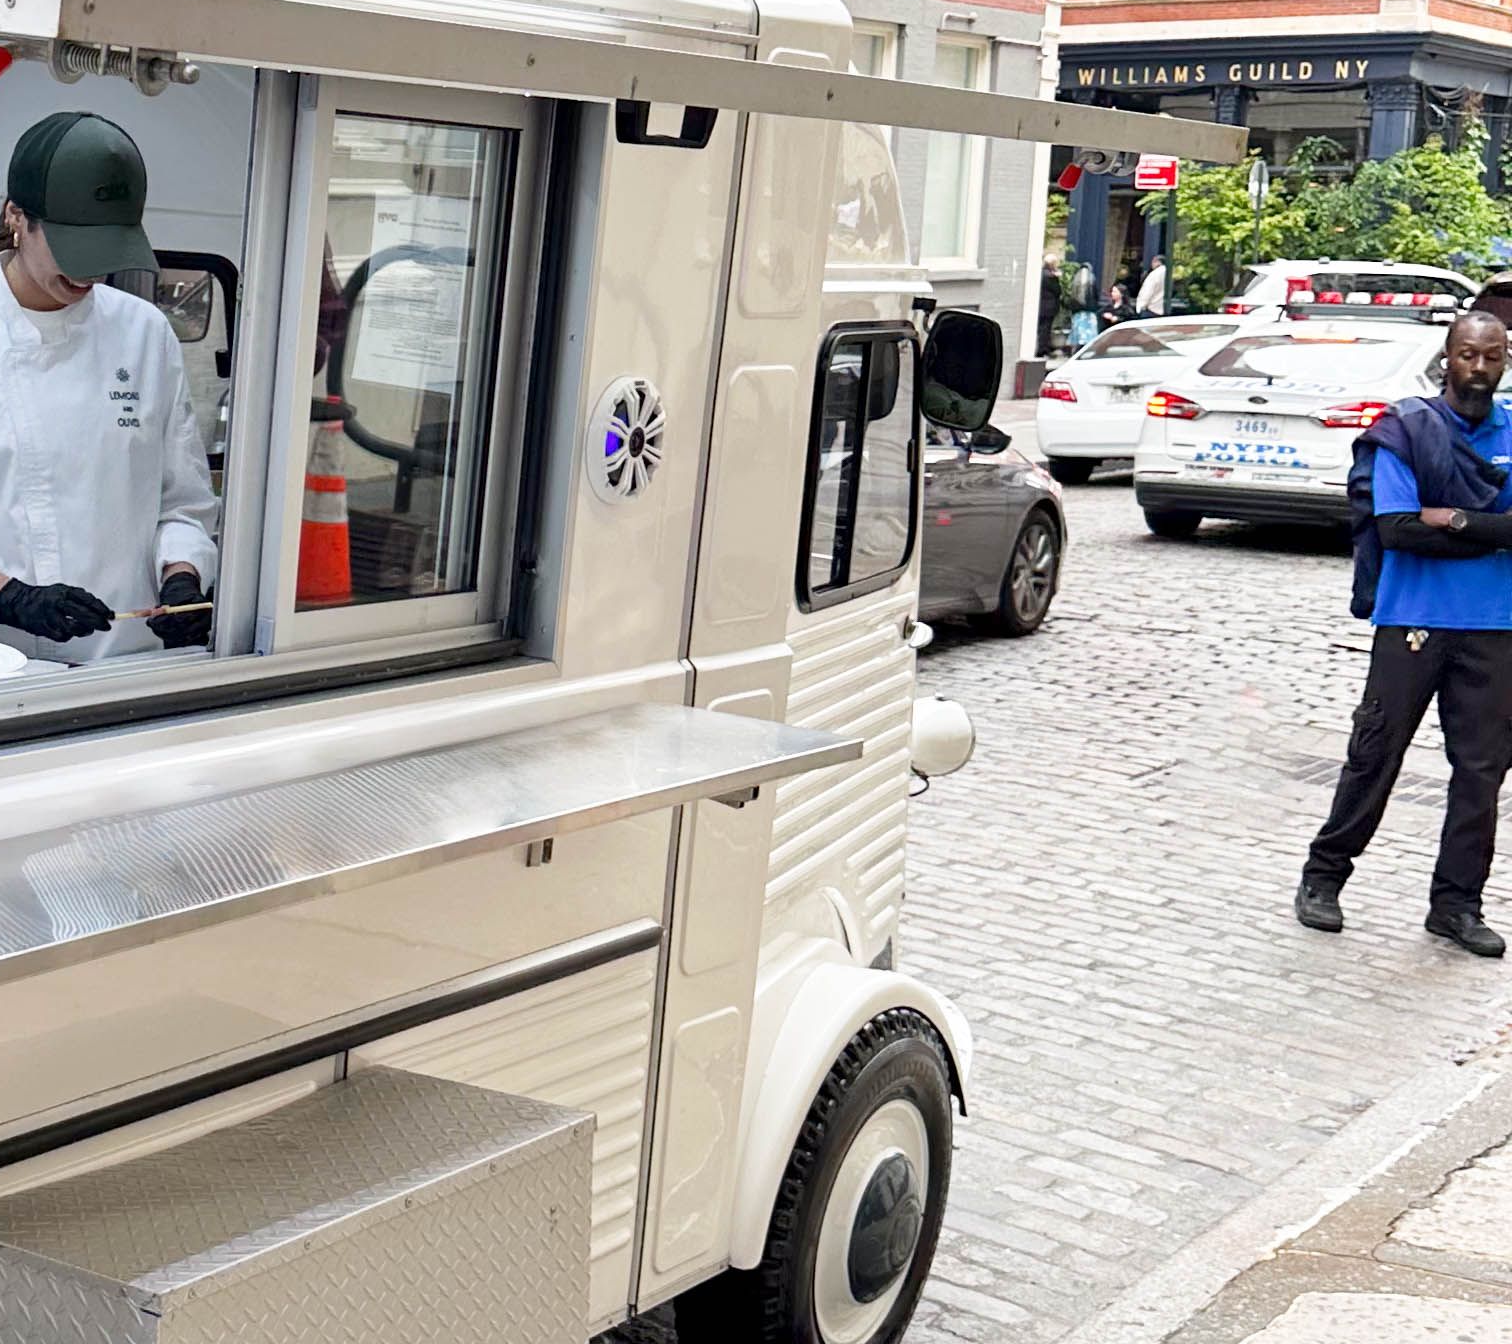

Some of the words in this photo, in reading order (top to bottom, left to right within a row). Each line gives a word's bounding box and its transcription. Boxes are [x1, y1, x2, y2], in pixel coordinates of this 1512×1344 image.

[1077, 64, 1207, 86] WILLIAMS
[1228, 61, 1314, 82] GUILD
[1334, 59, 1369, 80] NY
[1234, 419, 1268, 433] 3469
[1209, 441, 1298, 455] NYPD
[1194, 452, 1310, 469] POLICE
